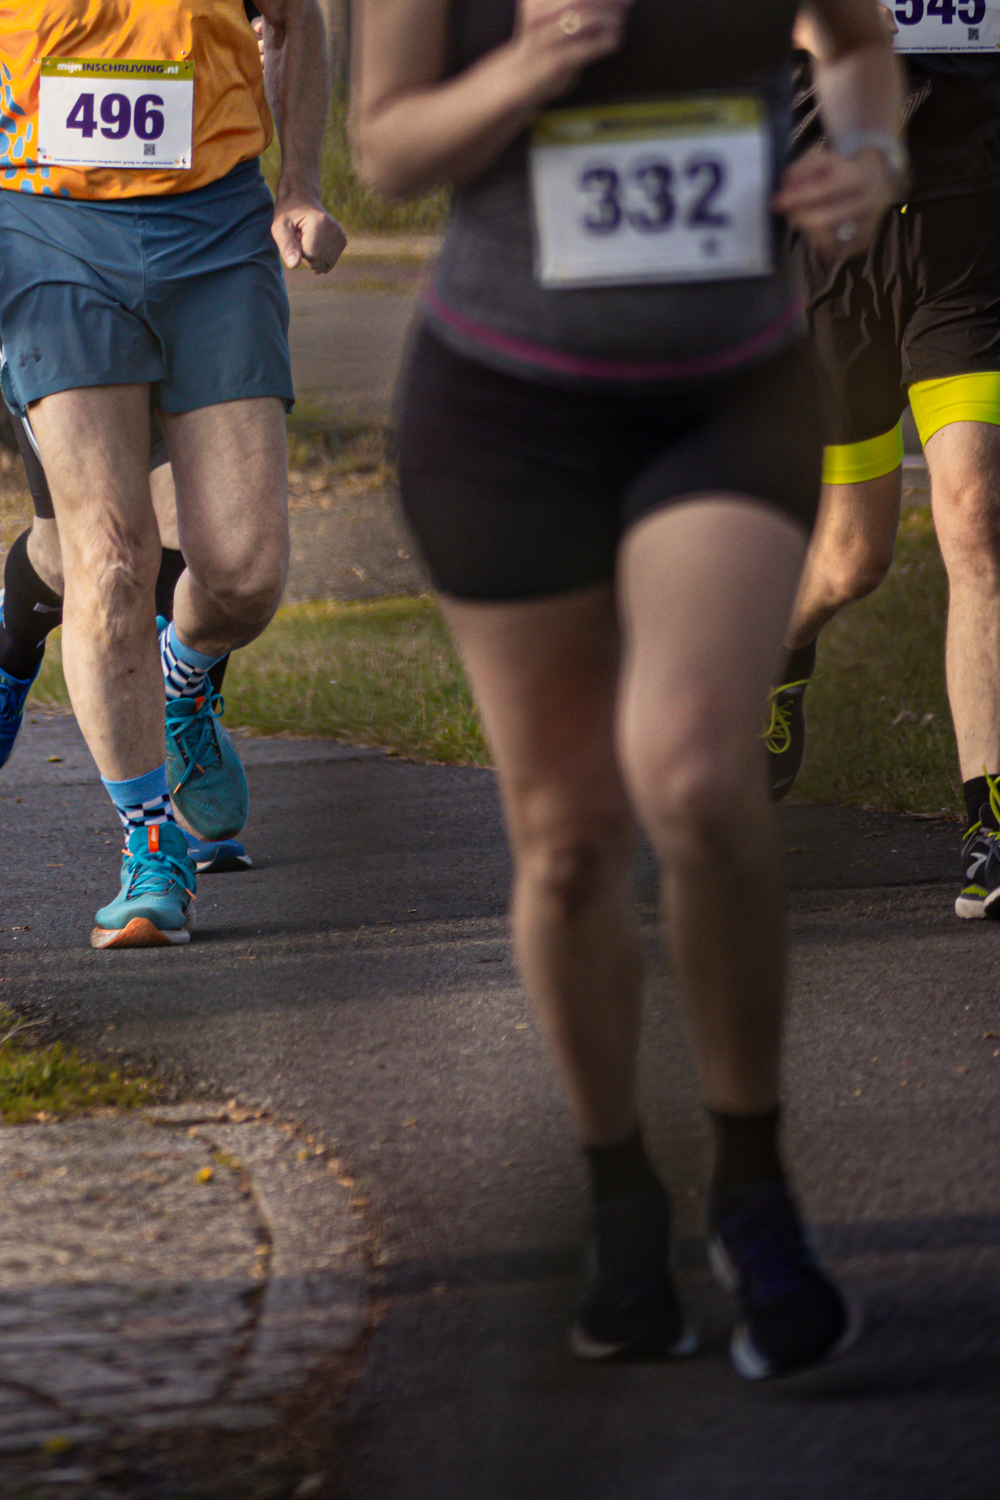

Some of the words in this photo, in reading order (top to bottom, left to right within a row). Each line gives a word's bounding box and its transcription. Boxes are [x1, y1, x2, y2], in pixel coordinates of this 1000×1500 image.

[57, 62, 179, 75] mijnINSCHRIJVING.nl
[65, 92, 165, 141] 496
[578, 157, 733, 237] 332
